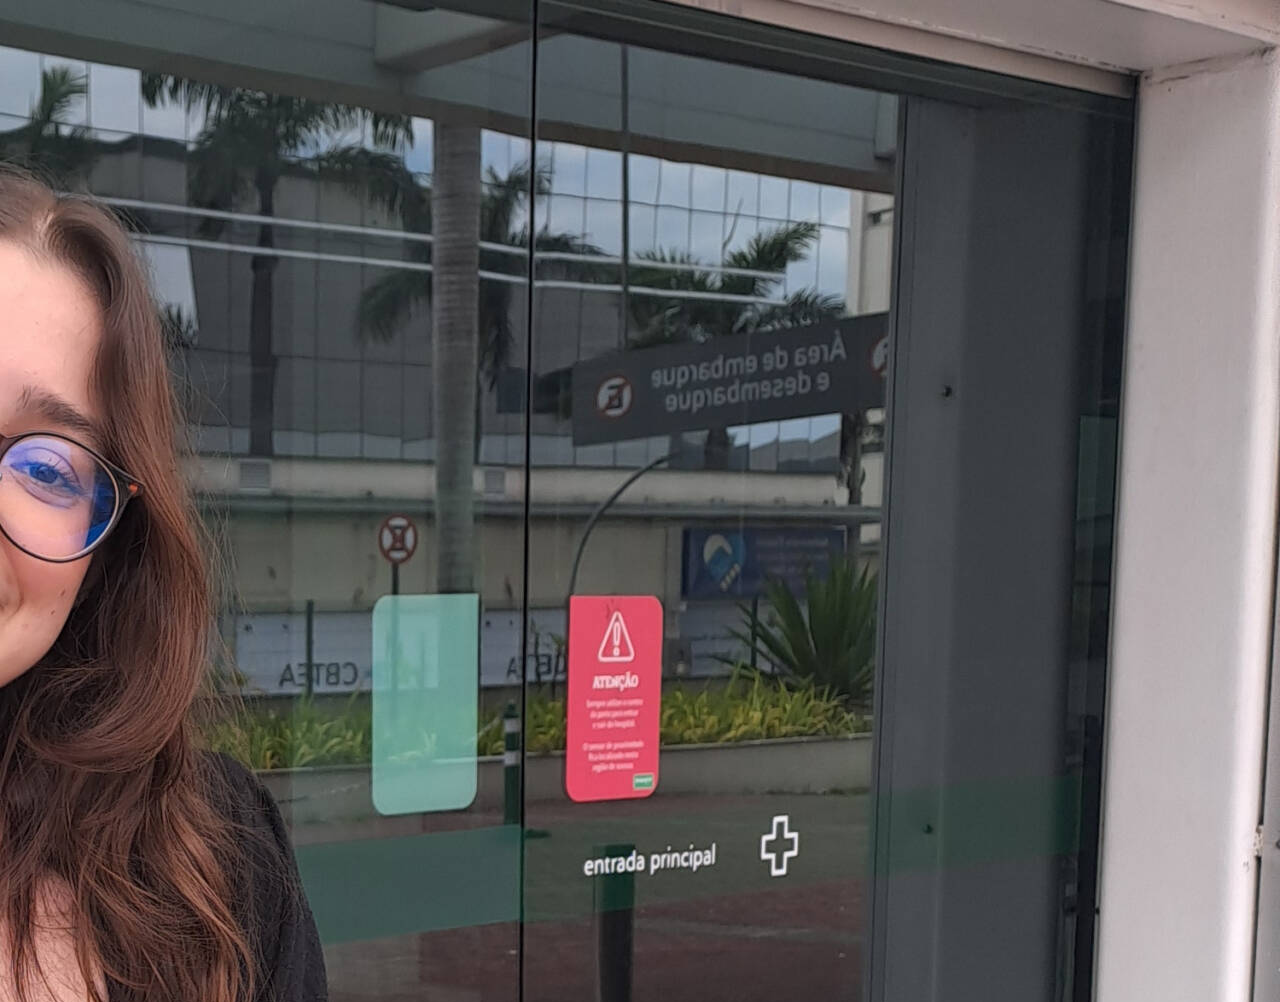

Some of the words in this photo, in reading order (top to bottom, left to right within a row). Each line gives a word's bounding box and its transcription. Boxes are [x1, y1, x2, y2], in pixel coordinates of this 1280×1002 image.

[592, 671, 639, 692] ATENÇÃO
[583, 850, 645, 876] entrada
[650, 842, 716, 875] principal
